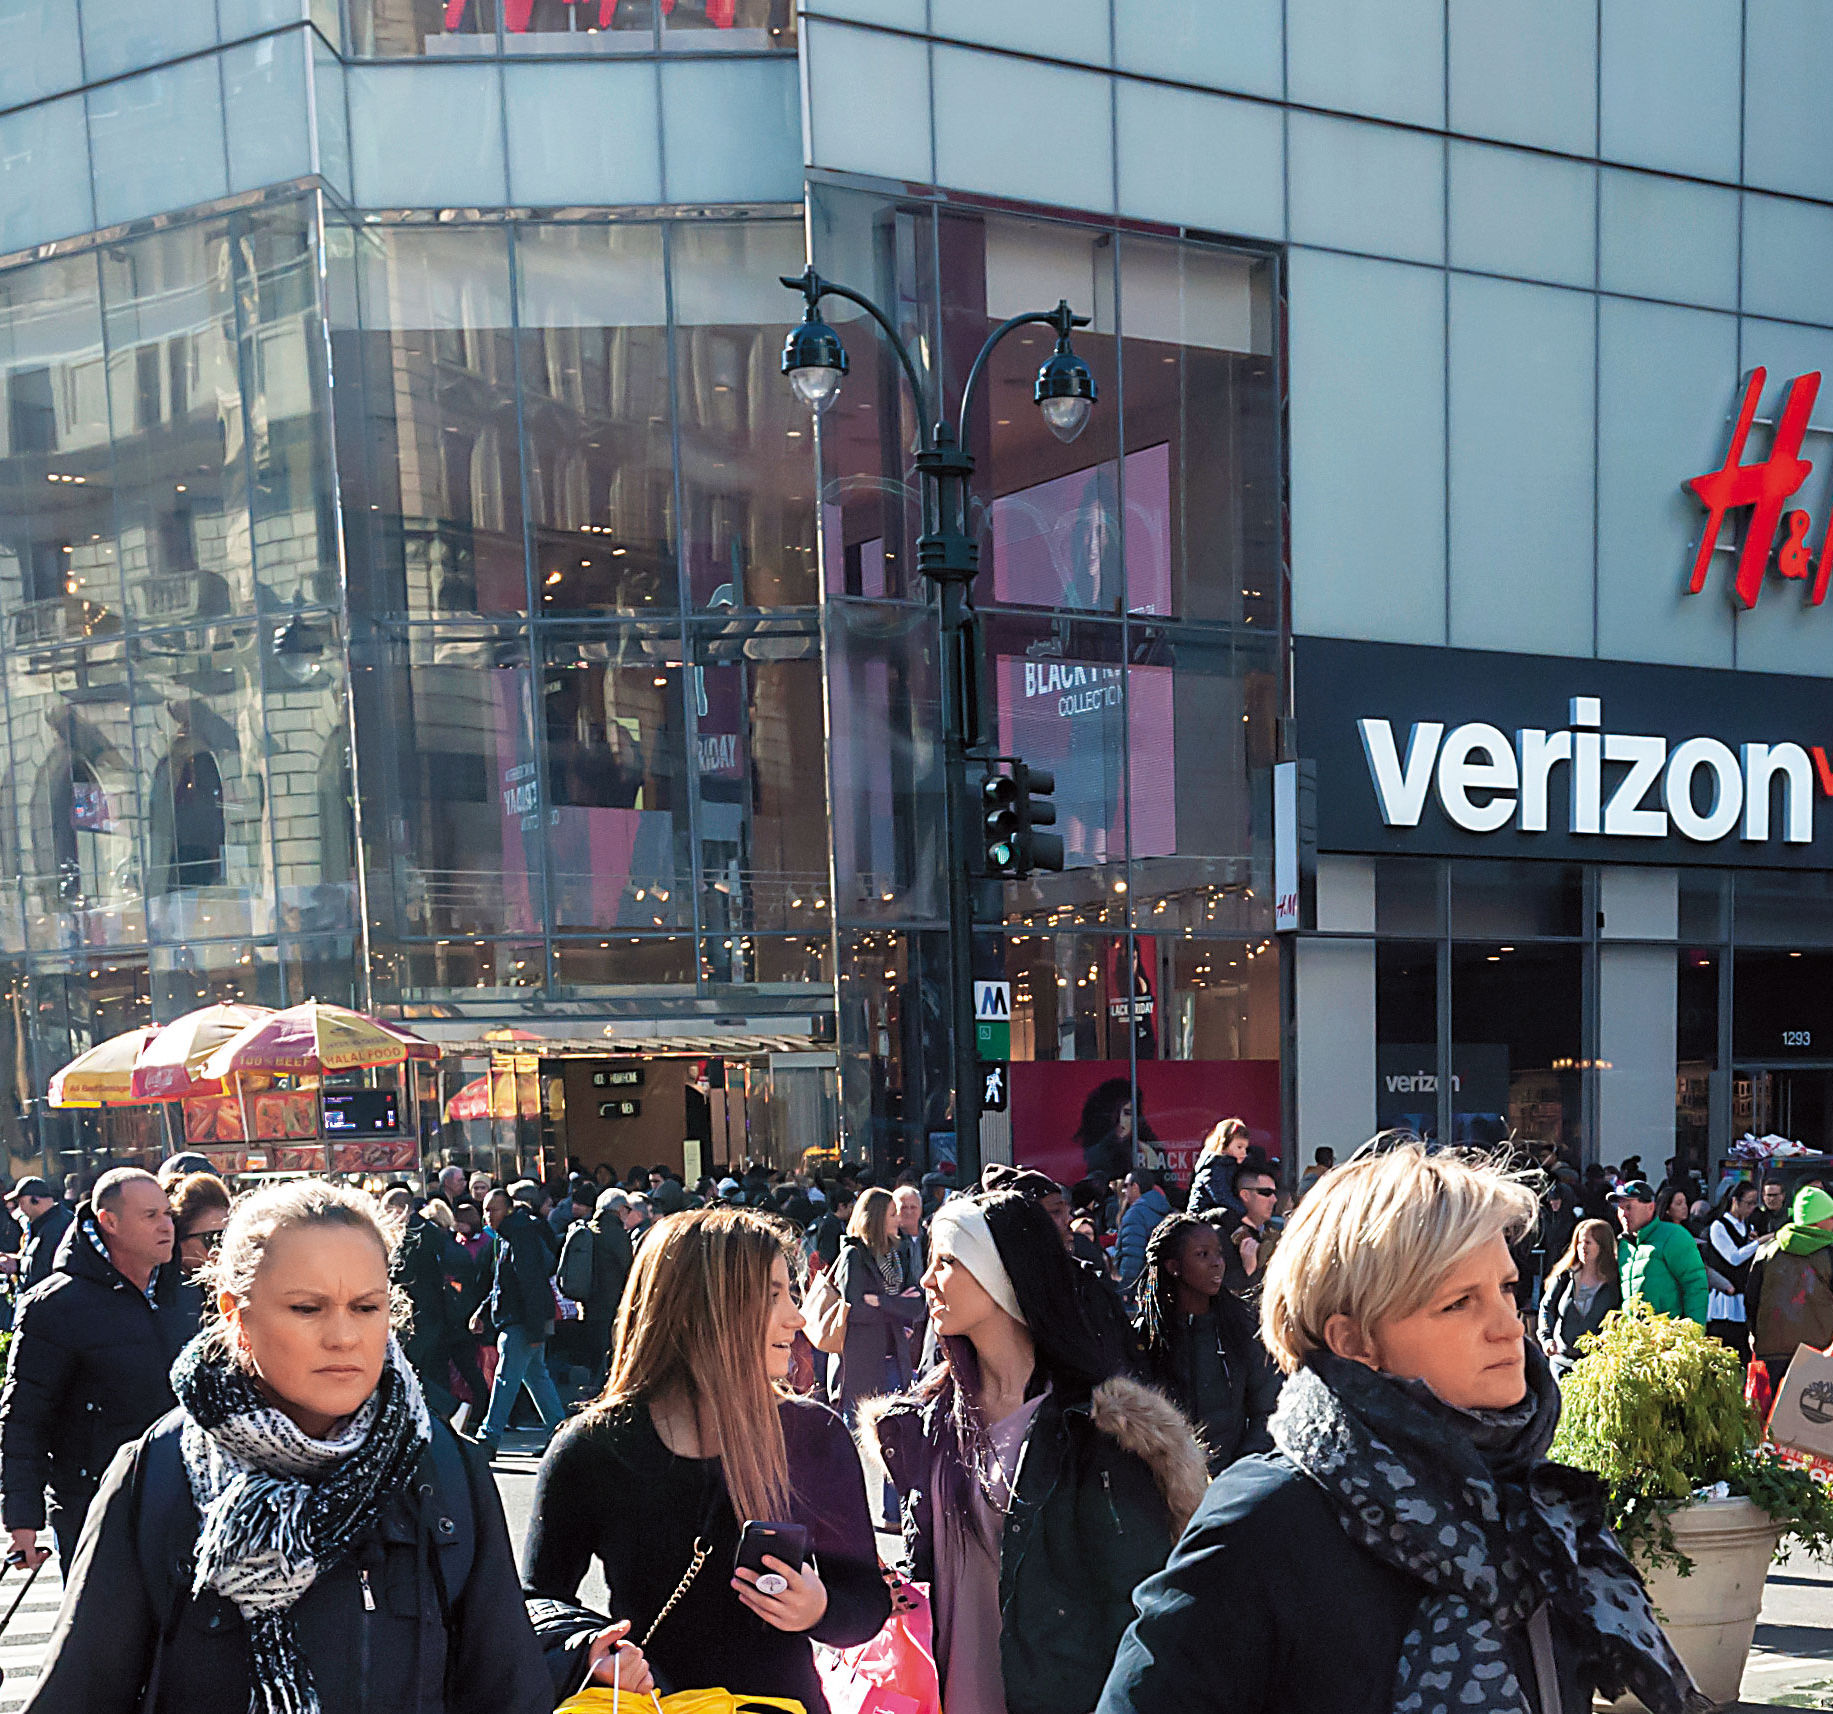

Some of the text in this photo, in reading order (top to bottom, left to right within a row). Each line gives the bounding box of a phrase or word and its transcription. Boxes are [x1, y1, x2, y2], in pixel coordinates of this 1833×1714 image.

[1357, 696, 1815, 844] verizon
[1276, 894, 1298, 918] H&M
[1782, 1031, 1810, 1046] 1293
[275, 1055, 313, 1068] BEEF
[325, 1046, 401, 1065] HALAL FOOD
[1386, 1070, 1460, 1092] verizn
